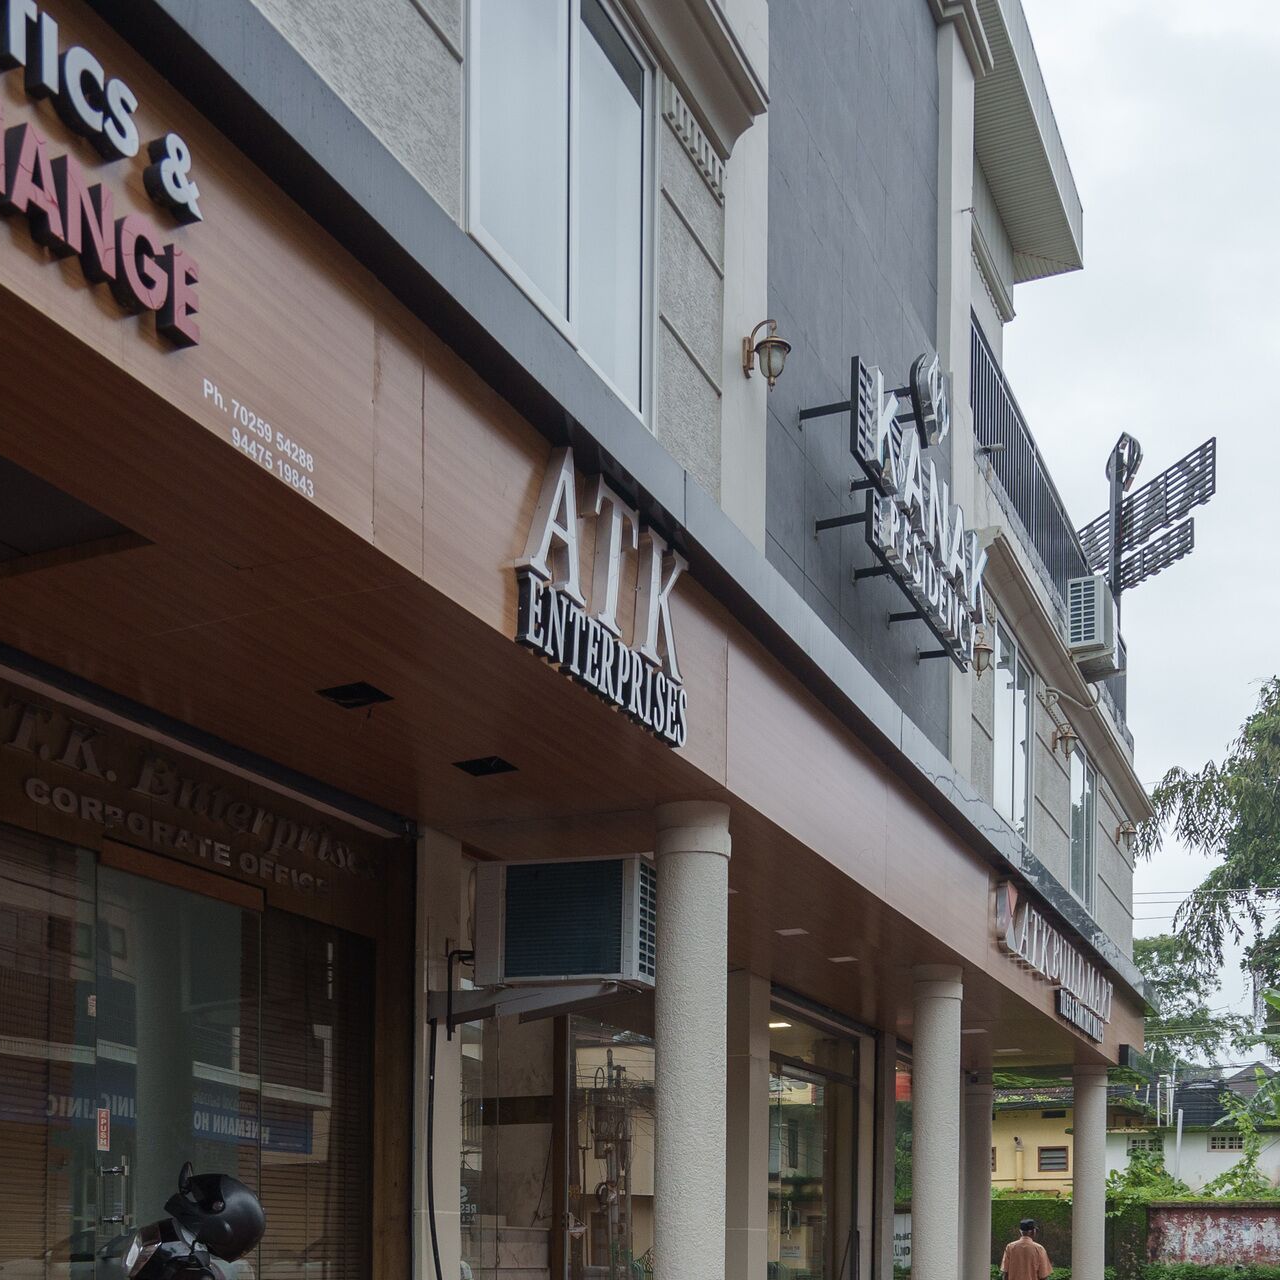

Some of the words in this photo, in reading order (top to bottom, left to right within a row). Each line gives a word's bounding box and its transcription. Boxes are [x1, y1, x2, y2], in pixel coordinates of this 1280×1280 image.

[155, 133, 202, 222] &
[203, 378, 227, 412] Ph.
[231, 399, 272, 443] 70259
[276, 432, 314, 473] 54288
[231, 427, 273, 470] 94475
[277, 459, 314, 498] 19843
[876, 366, 989, 628] KANAK
[524, 447, 689, 685] ATK
[889, 495, 981, 664] RESIDENCY
[523, 572, 689, 748] ENTERPRISES
[24, 777, 233, 868] CORPORATE
[239, 850, 330, 897] OFFICE
